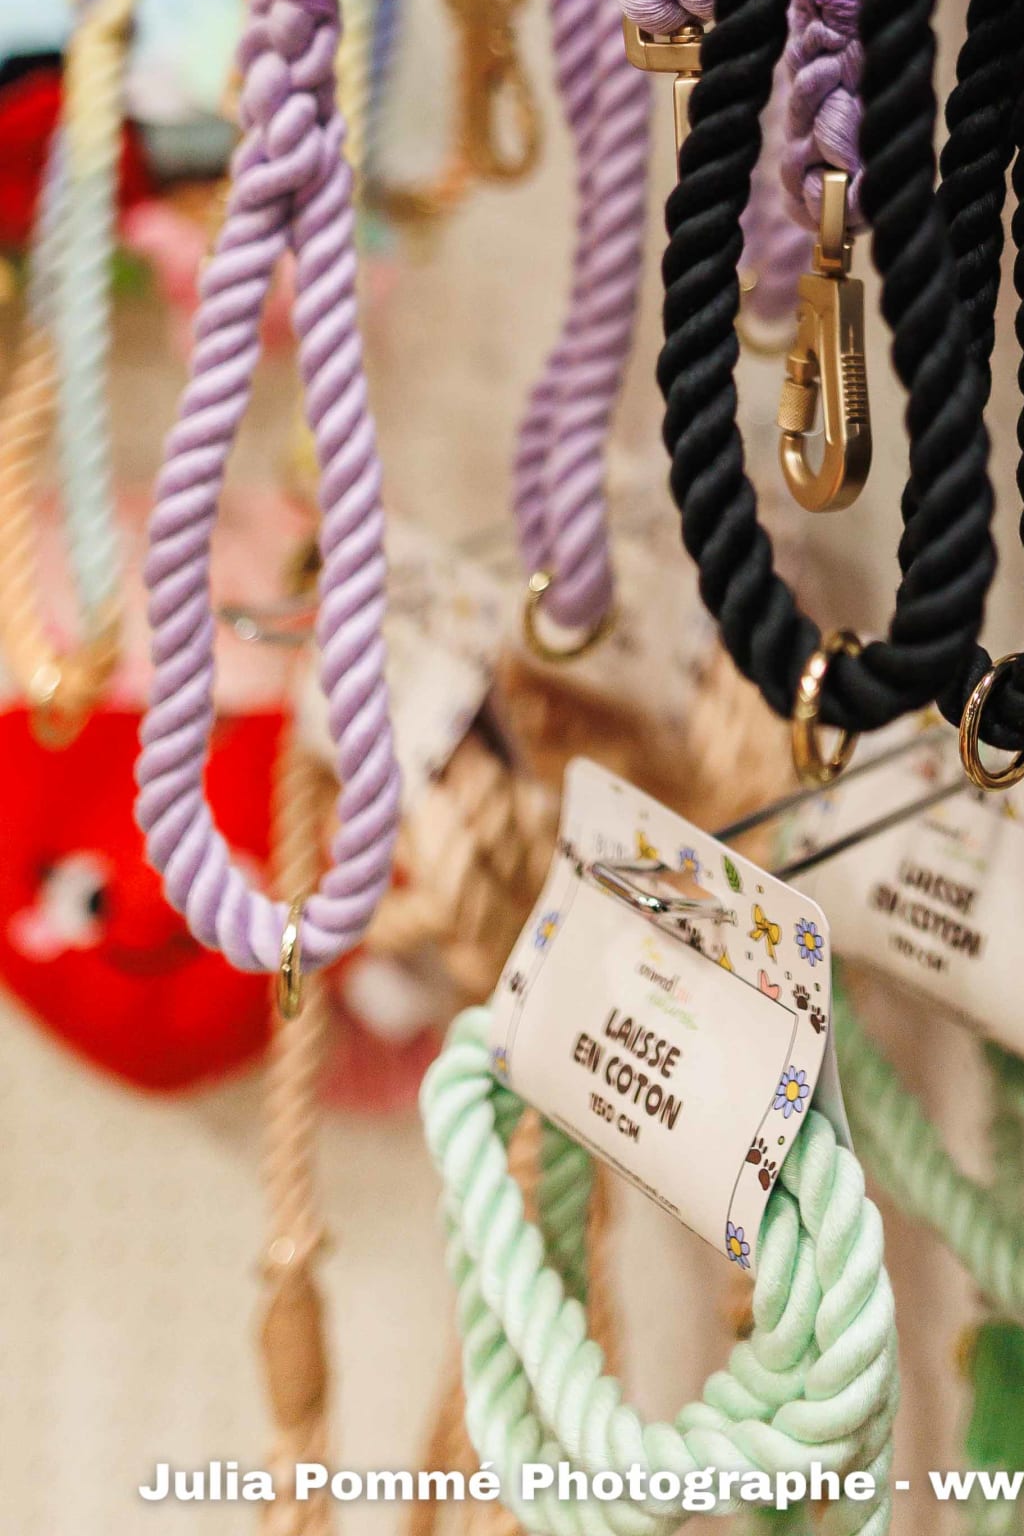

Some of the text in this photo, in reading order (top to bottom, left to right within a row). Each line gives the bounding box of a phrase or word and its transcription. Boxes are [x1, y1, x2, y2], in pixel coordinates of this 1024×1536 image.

[574, 1033, 682, 1130] EN COTON
[606, 1009, 681, 1078] LAISSE
